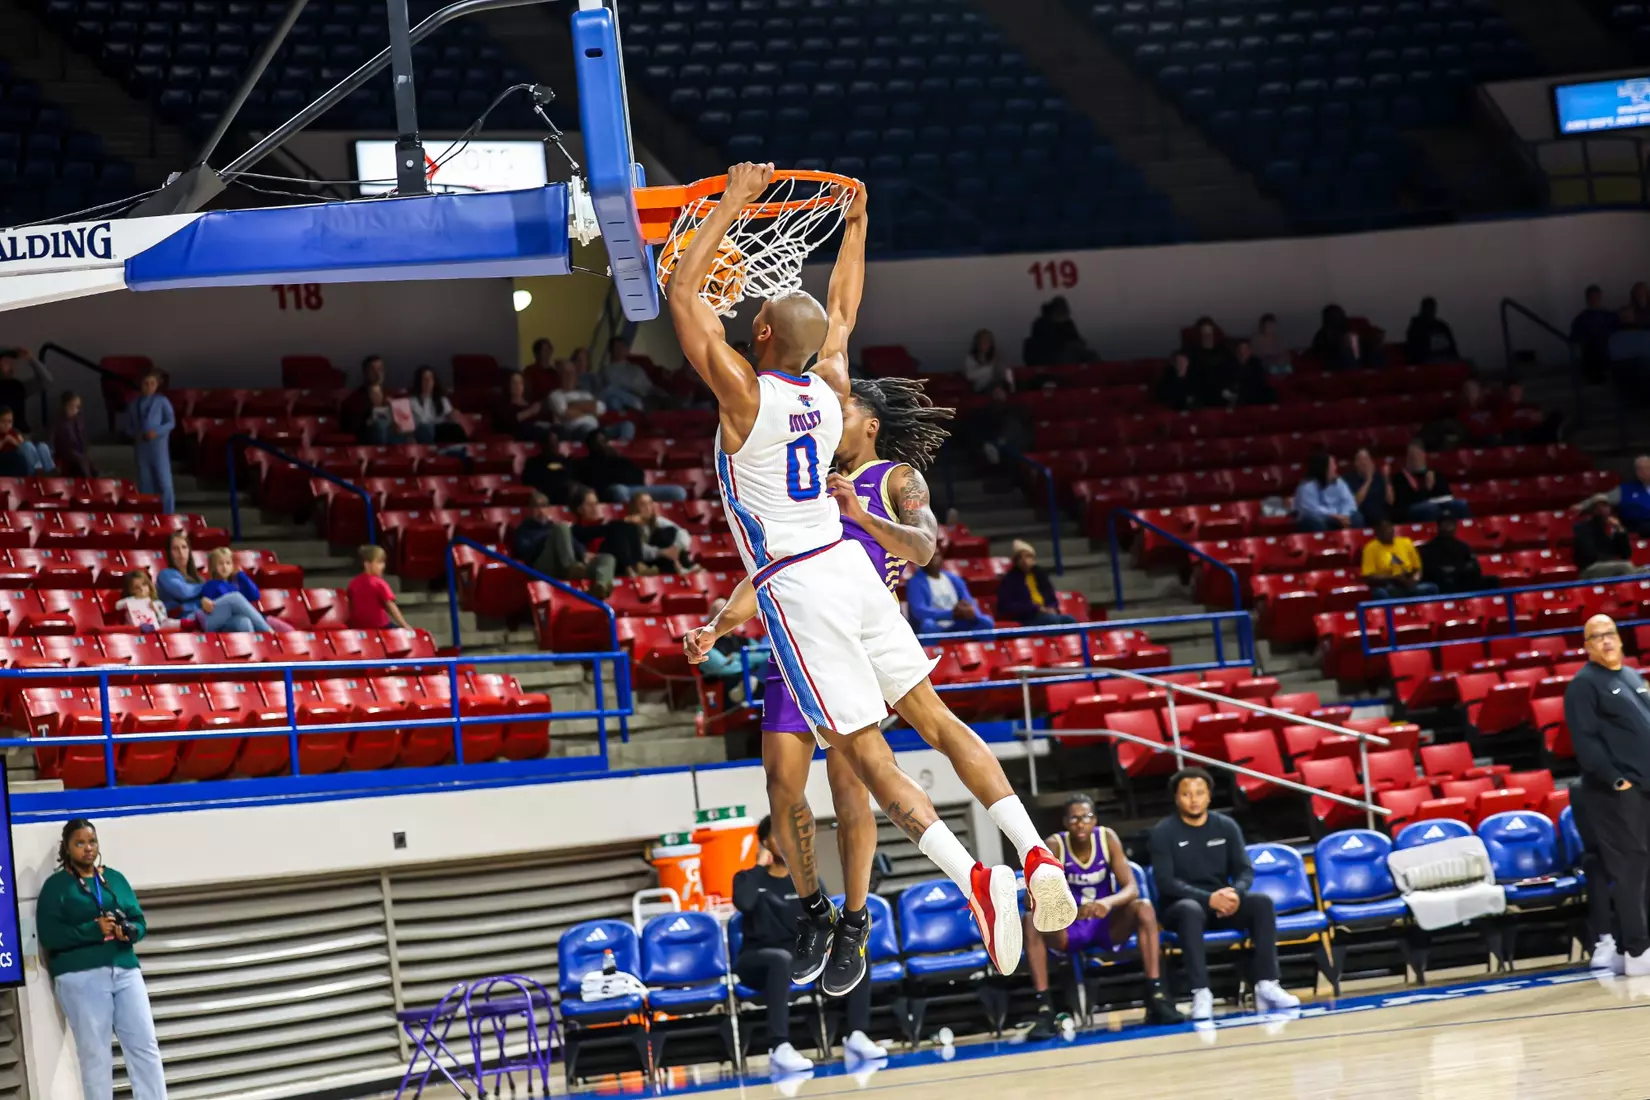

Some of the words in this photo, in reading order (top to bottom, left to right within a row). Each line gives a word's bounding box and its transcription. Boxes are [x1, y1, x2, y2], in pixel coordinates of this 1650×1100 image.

[1027, 260, 1079, 291] 119
[271, 283, 323, 310] 118
[786, 433, 821, 502] 0
